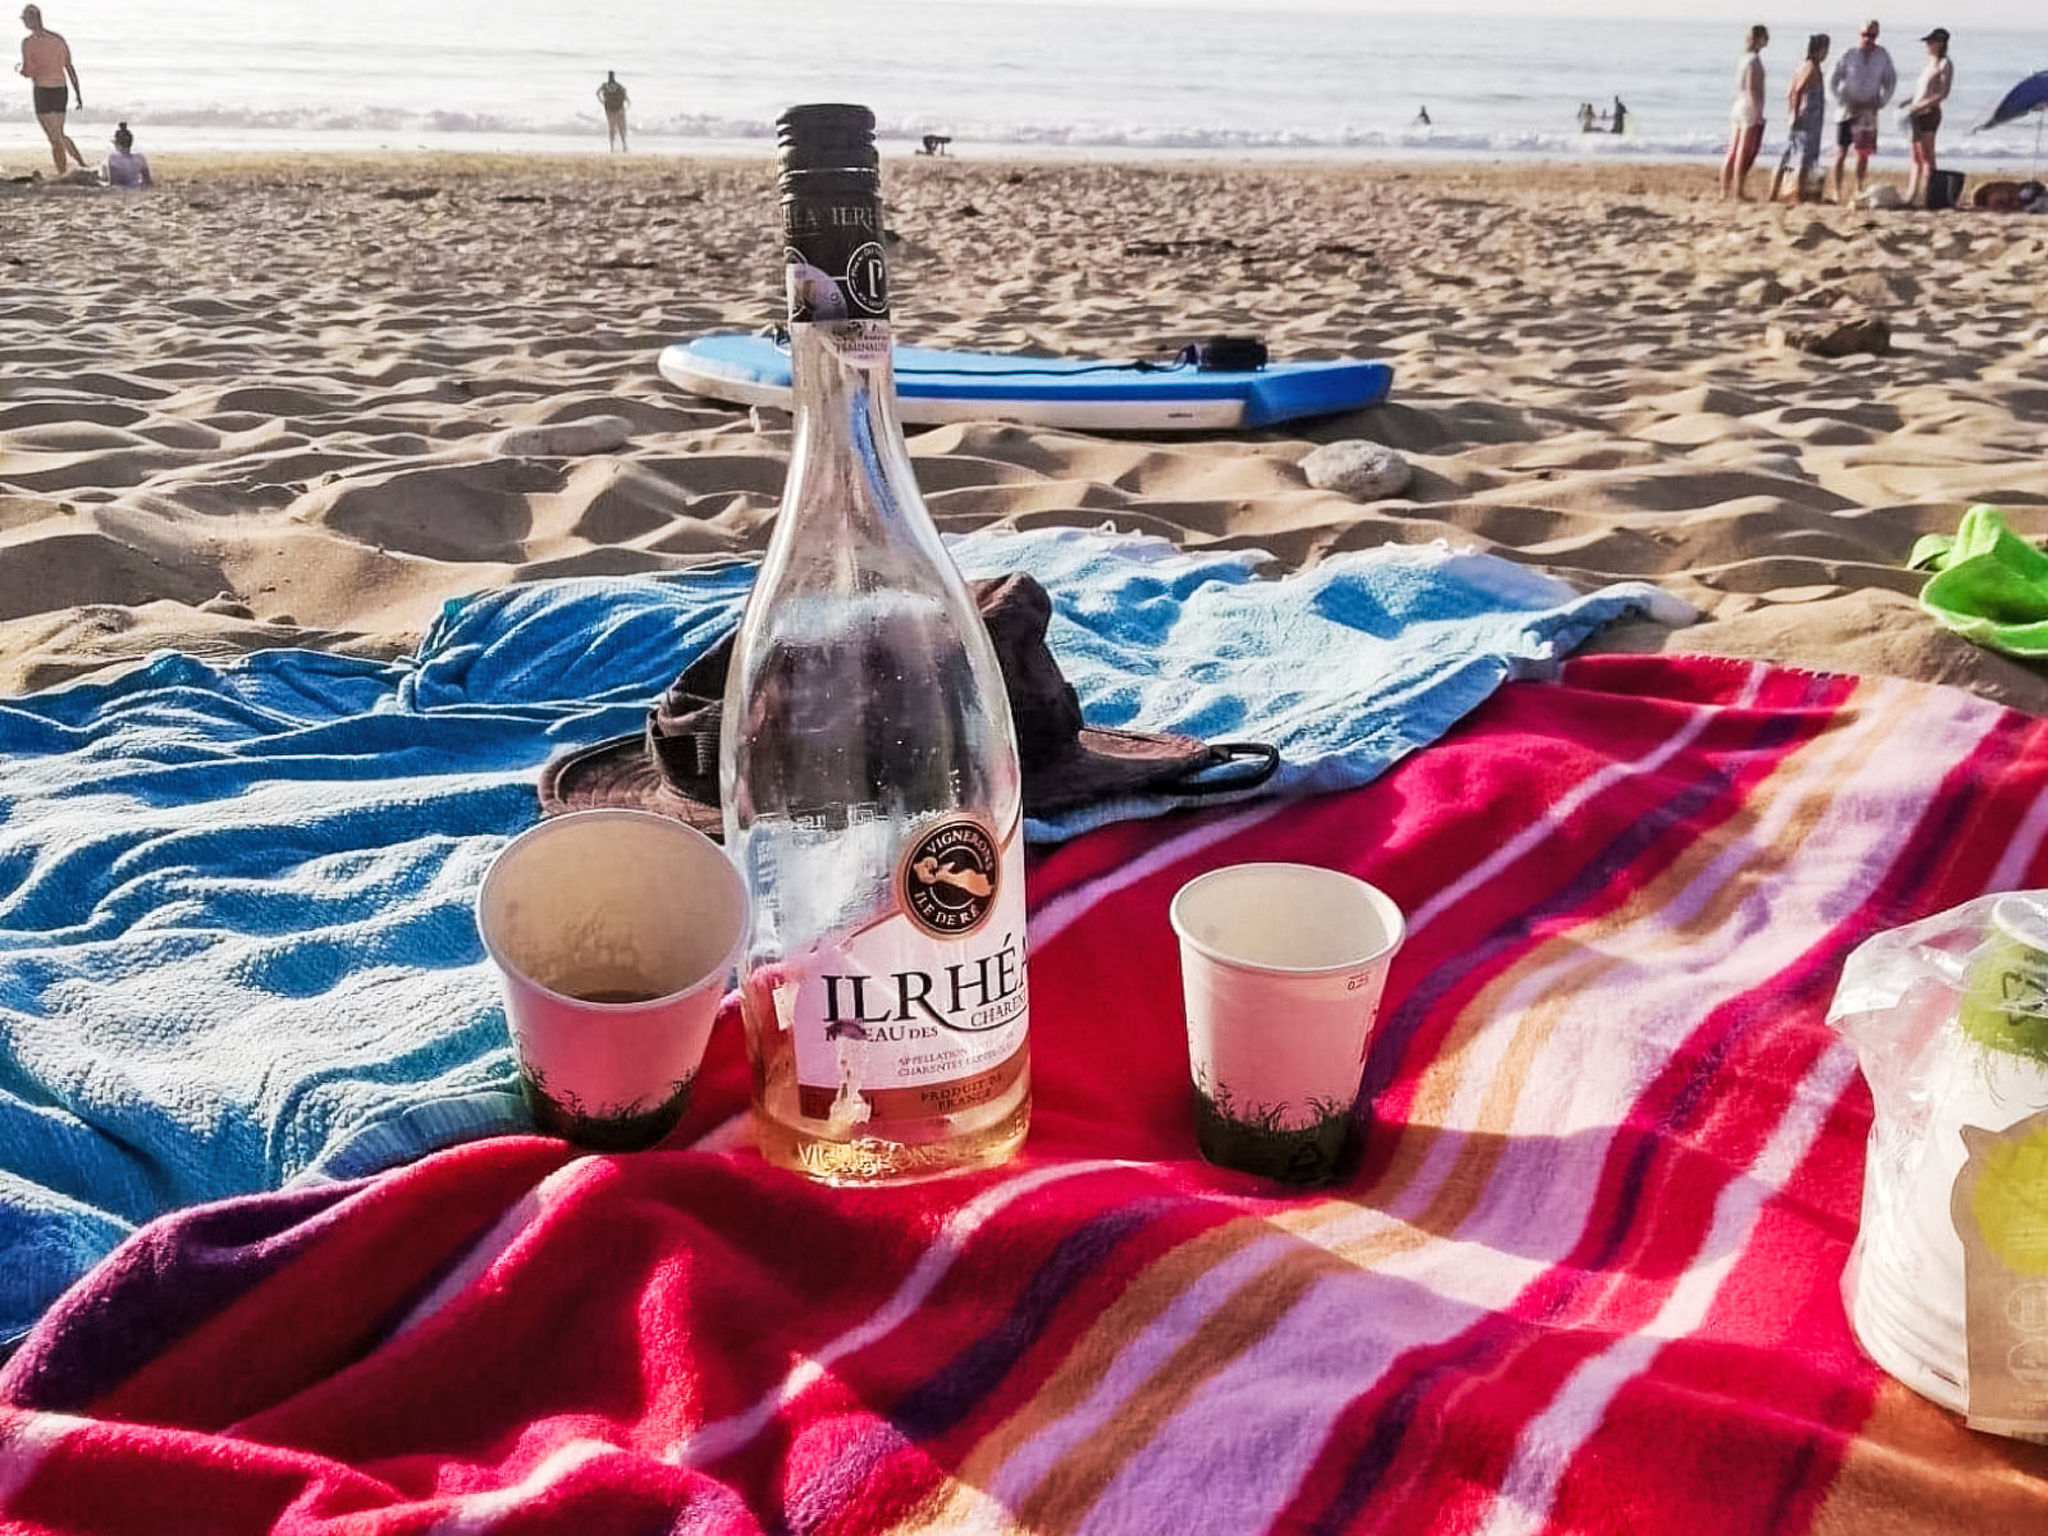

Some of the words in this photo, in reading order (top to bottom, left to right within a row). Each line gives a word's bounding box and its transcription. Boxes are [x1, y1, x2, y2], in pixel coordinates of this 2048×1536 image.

[926, 829, 994, 871] VIGNERONS
[914, 891, 936, 916] ILE
[935, 911, 958, 925] DE
[909, 1025, 938, 1040] DES
[920, 1079, 985, 1104] PRODUIT
